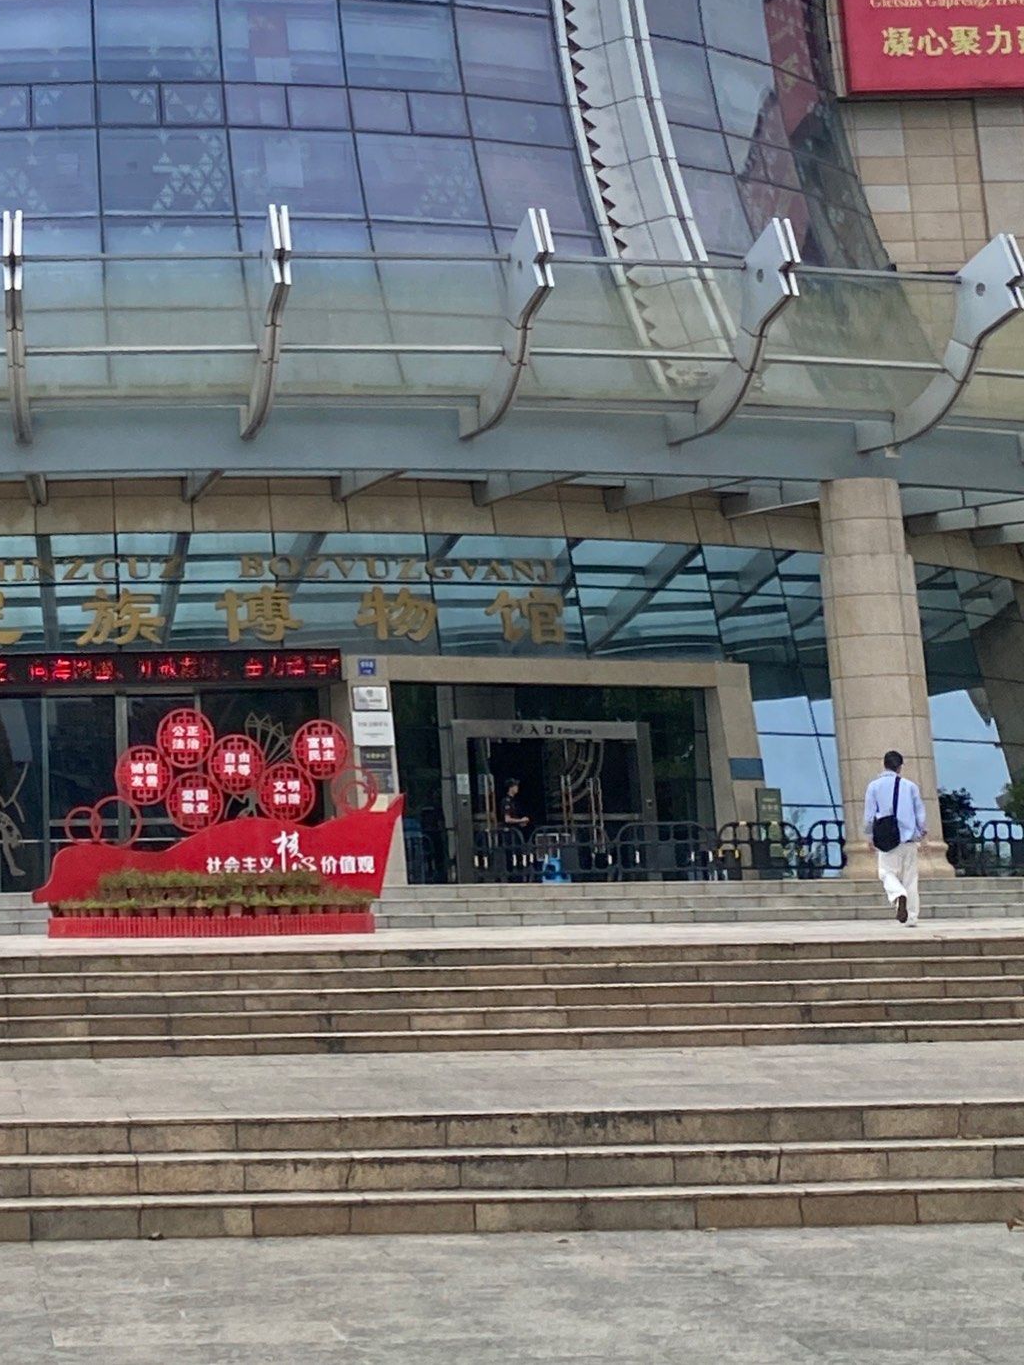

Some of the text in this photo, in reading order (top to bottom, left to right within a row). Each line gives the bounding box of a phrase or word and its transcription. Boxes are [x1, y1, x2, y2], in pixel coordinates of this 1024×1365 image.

[238, 555, 559, 582] BOZVUZGVANJ
[172, 726, 200, 736] 公正
[172, 738, 200, 749] 法治
[307, 737, 335, 748] 富强
[224, 752, 251, 763] 自由
[308, 749, 336, 761] 民主
[130, 762, 158, 774] 诚信
[224, 764, 251, 776] 平等
[130, 775, 158, 787] 友善
[273, 780, 301, 792] 文明
[182, 789, 209, 801] 爱国
[273, 793, 301, 805] 和谐
[182, 802, 209, 814] 敬业
[206, 831, 375, 874] 社会主义核心价值观
